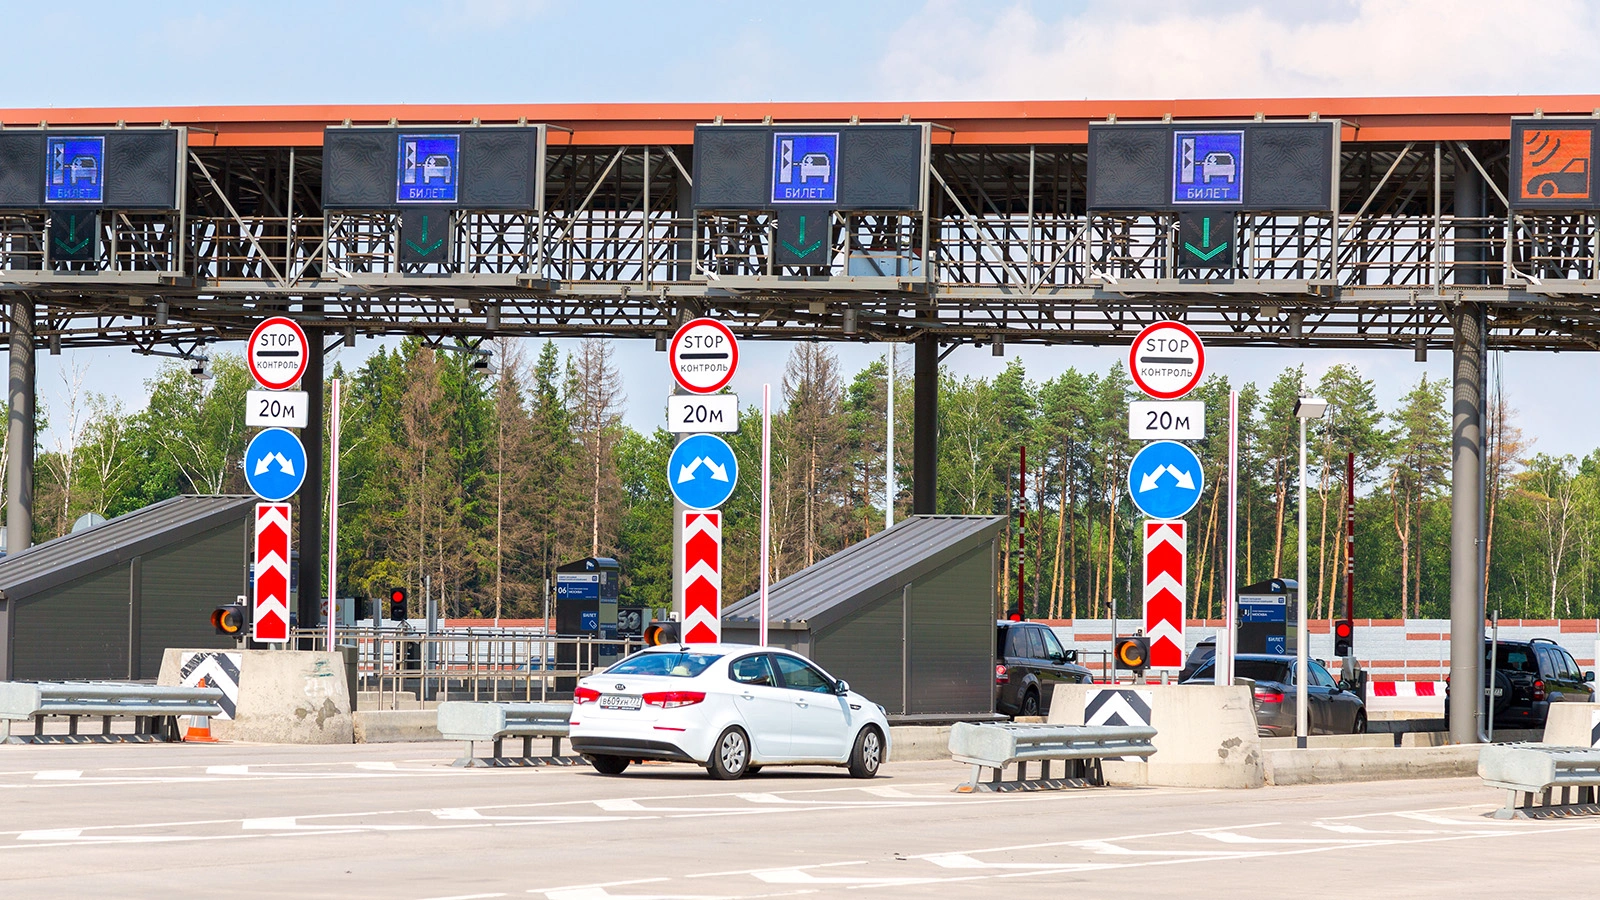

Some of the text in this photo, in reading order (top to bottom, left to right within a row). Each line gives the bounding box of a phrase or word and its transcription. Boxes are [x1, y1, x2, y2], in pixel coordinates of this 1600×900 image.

[57, 188, 93, 198] БИЛЕТ
[409, 188, 447, 198] БИЛЕТ
[785, 188, 825, 198] БИЛЕТ
[1187, 188, 1230, 198] БИЛЕТ
[260, 333, 296, 346] STOP
[684, 335, 724, 349] STOP
[1146, 338, 1189, 353] STOP
[256, 361, 298, 369] КОНТРОЛЬ
[680, 363, 728, 372] КОНТРОЛЬ
[1141, 368, 1193, 378] КОНТРОЛЬ
